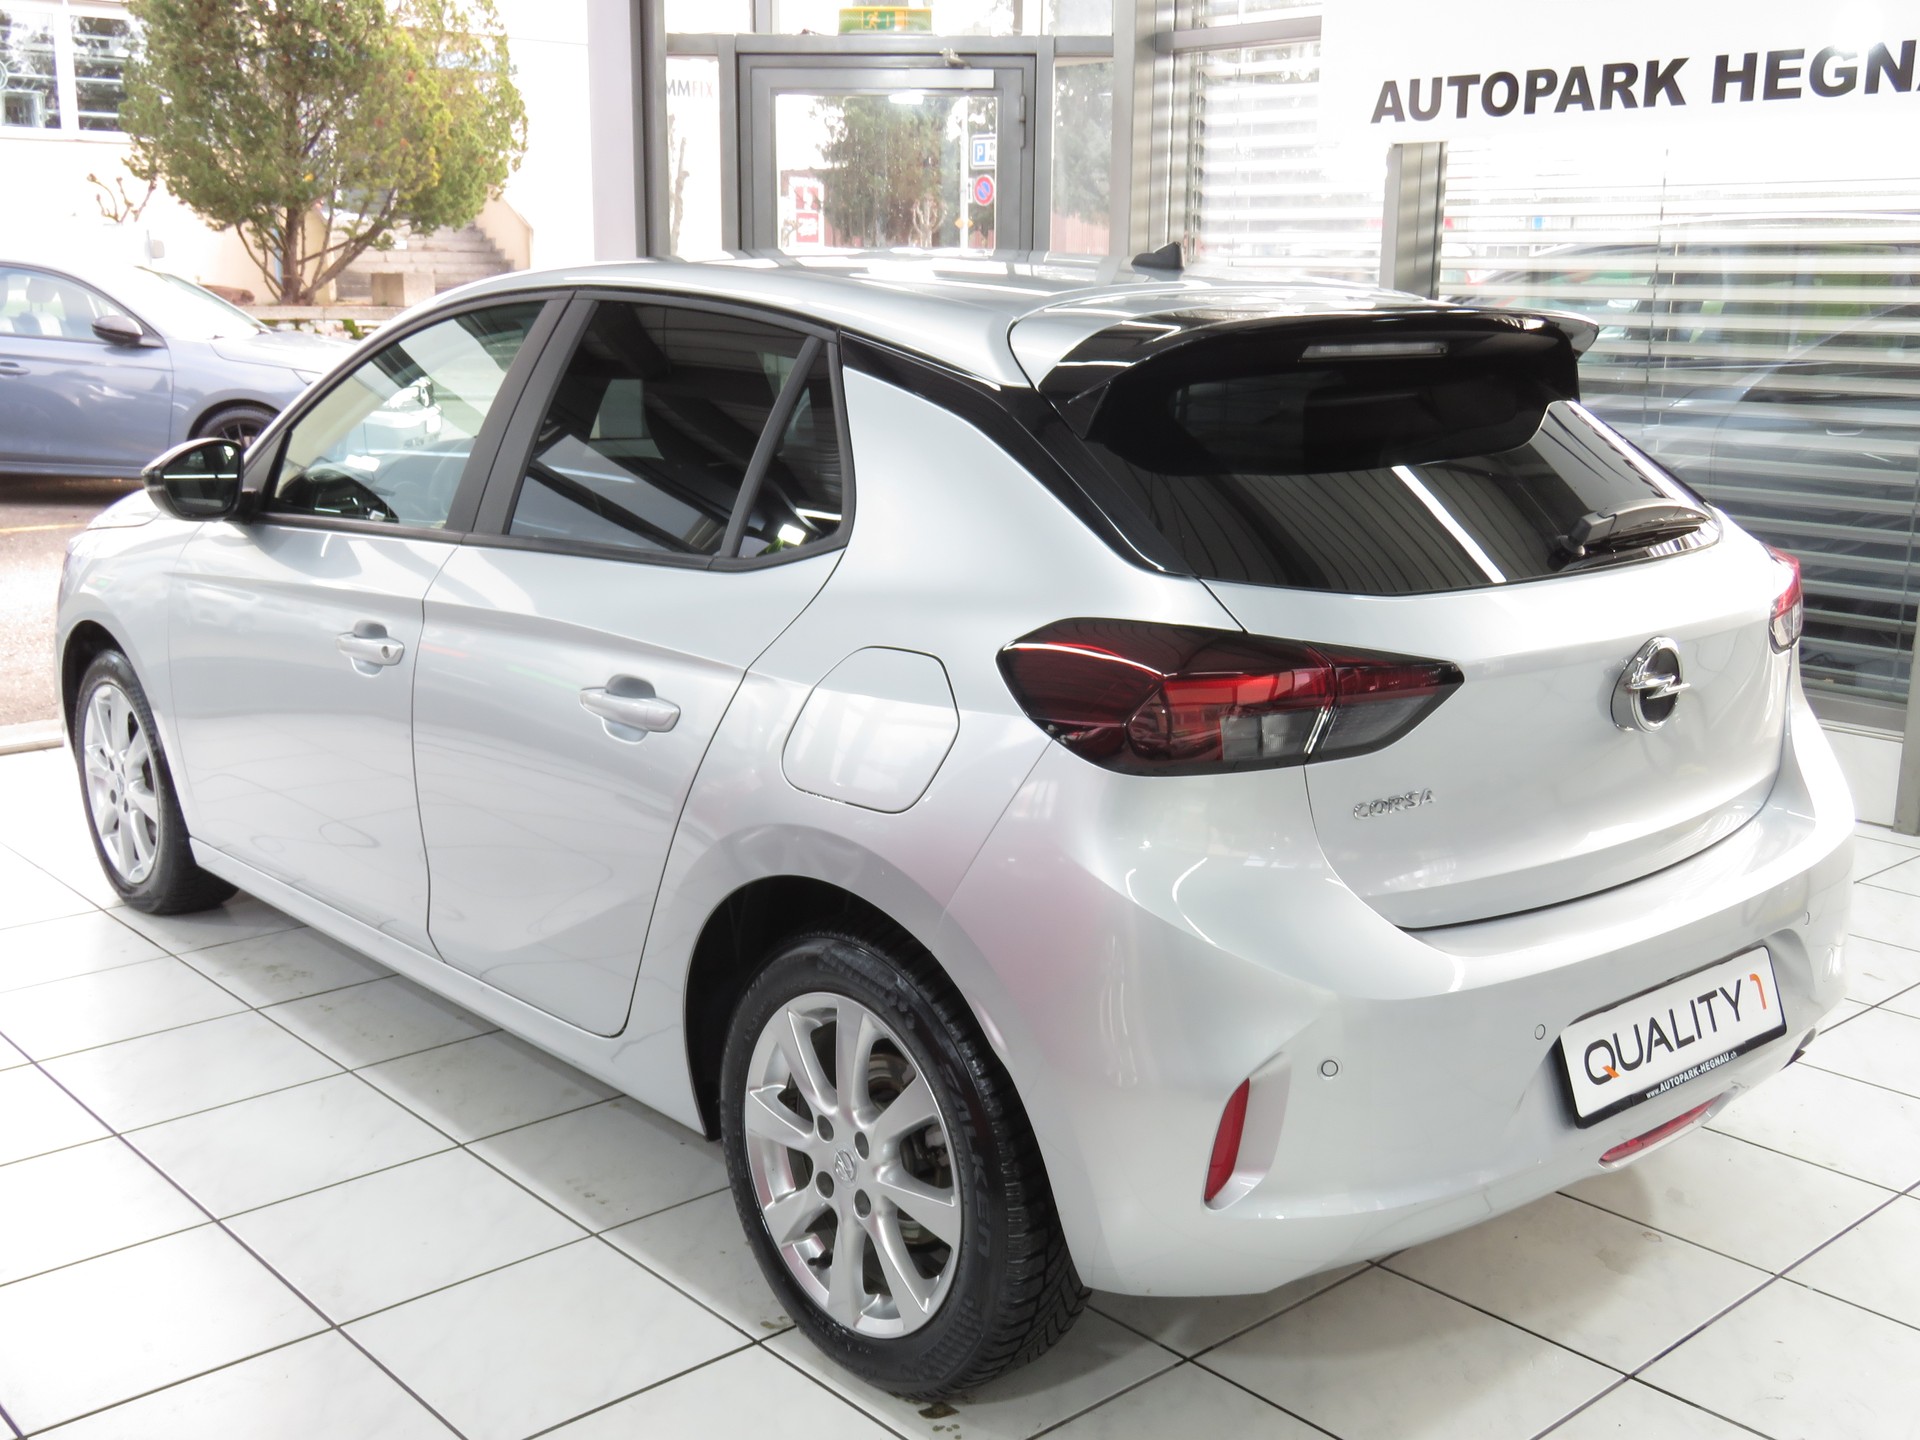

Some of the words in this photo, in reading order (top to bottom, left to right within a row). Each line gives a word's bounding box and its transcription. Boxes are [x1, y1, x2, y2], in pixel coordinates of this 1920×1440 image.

[1371, 58, 1689, 123] AUTOPARK
[1711, 40, 1920, 103] HEGN
[1353, 789, 1434, 819] CORSA
[1584, 979, 1742, 1085] QUALITY
[1645, 1051, 1738, 1099] www.AUTOPARK-HEGNAU.ch
